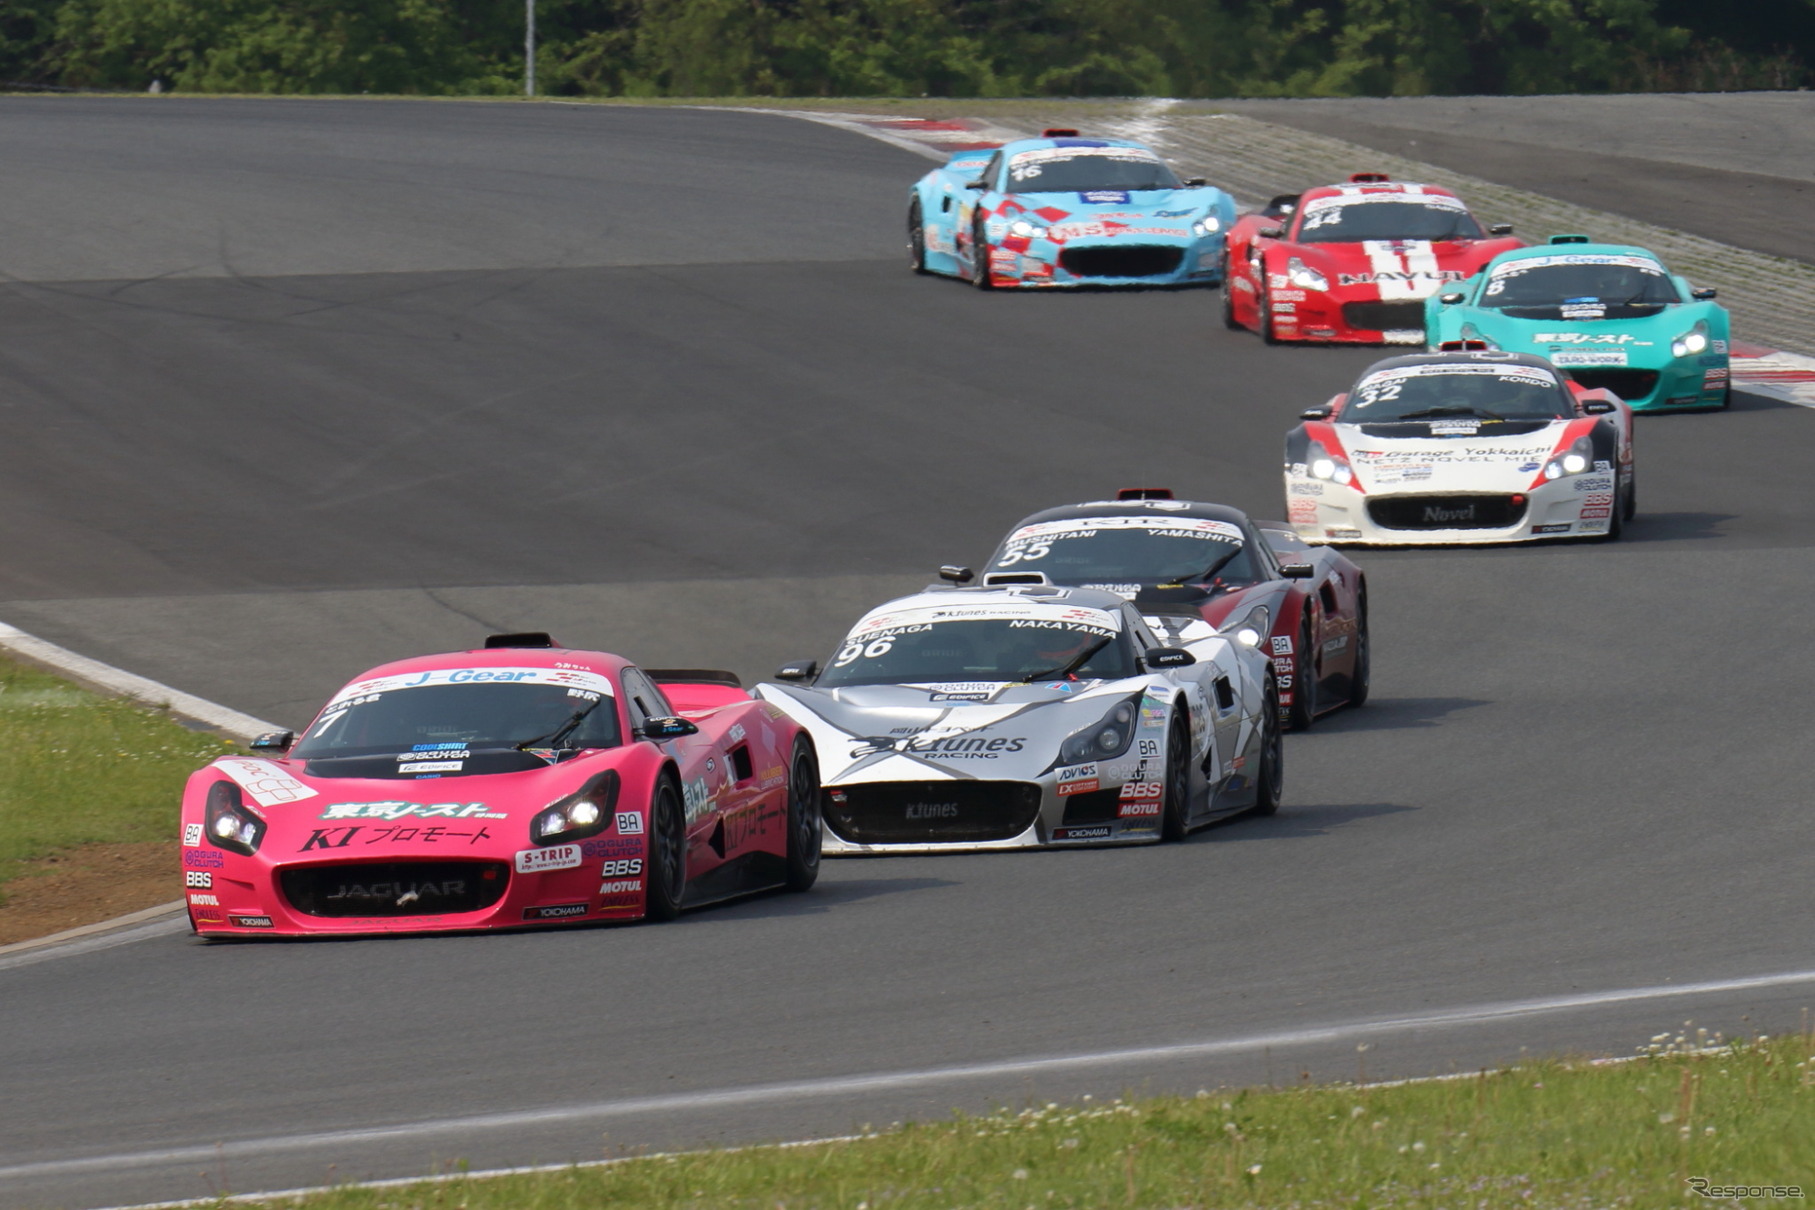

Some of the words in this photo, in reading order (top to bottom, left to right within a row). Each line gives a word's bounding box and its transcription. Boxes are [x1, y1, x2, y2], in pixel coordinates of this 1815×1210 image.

[1011, 165, 1043, 181] 16
[1486, 280, 1506, 296] 8
[1499, 376, 1551, 388] KONDO
[1355, 385, 1402, 408] 32
[1465, 446, 1552, 457] Yokkaichi
[1356, 457, 1411, 465] NETZ
[1421, 456, 1494, 464] NOVEL
[1504, 455, 1542, 463] MIE
[1584, 493, 1613, 505] BBS
[1422, 505, 1475, 522] Novel
[1004, 530, 1097, 551] MUSHITANI
[1147, 529, 1243, 547] YAMASHITA
[998, 541, 1053, 567] 55
[845, 623, 933, 648] SUENAGA
[1008, 620, 1117, 639] NAKAYAMA
[834, 636, 896, 667] 96
[1273, 637, 1288, 650] BA
[1273, 658, 1293, 666] URA
[404, 669, 537, 687] J-Gear
[314, 709, 348, 738] 7
[413, 742, 468, 751] COOLSHIRT
[1138, 740, 1157, 755] BA
[1060, 765, 1096, 781] ADVICS
[1119, 781, 1161, 798] BBS
[1120, 803, 1160, 816] MOTUL
[618, 814, 638, 830] BA
[185, 825, 200, 841] BA
[297, 825, 367, 852] KI
[366, 824, 491, 845] プロモート
[1067, 828, 1108, 838] YOKOHAMA
[597, 838, 642, 848] OGURA
[195, 850, 223, 860] OGURA
[524, 847, 573, 863] S-TRIP
[195, 859, 224, 869] CLUTCH
[602, 858, 643, 878] BBS
[186, 871, 212, 888] BBS
[599, 880, 641, 894] MOTUL
[327, 880, 465, 899] JAGUAR
[190, 894, 219, 906] MOTUL
[540, 907, 586, 918] YOKOHAMA
[240, 917, 273, 927] YOKOHAMA
